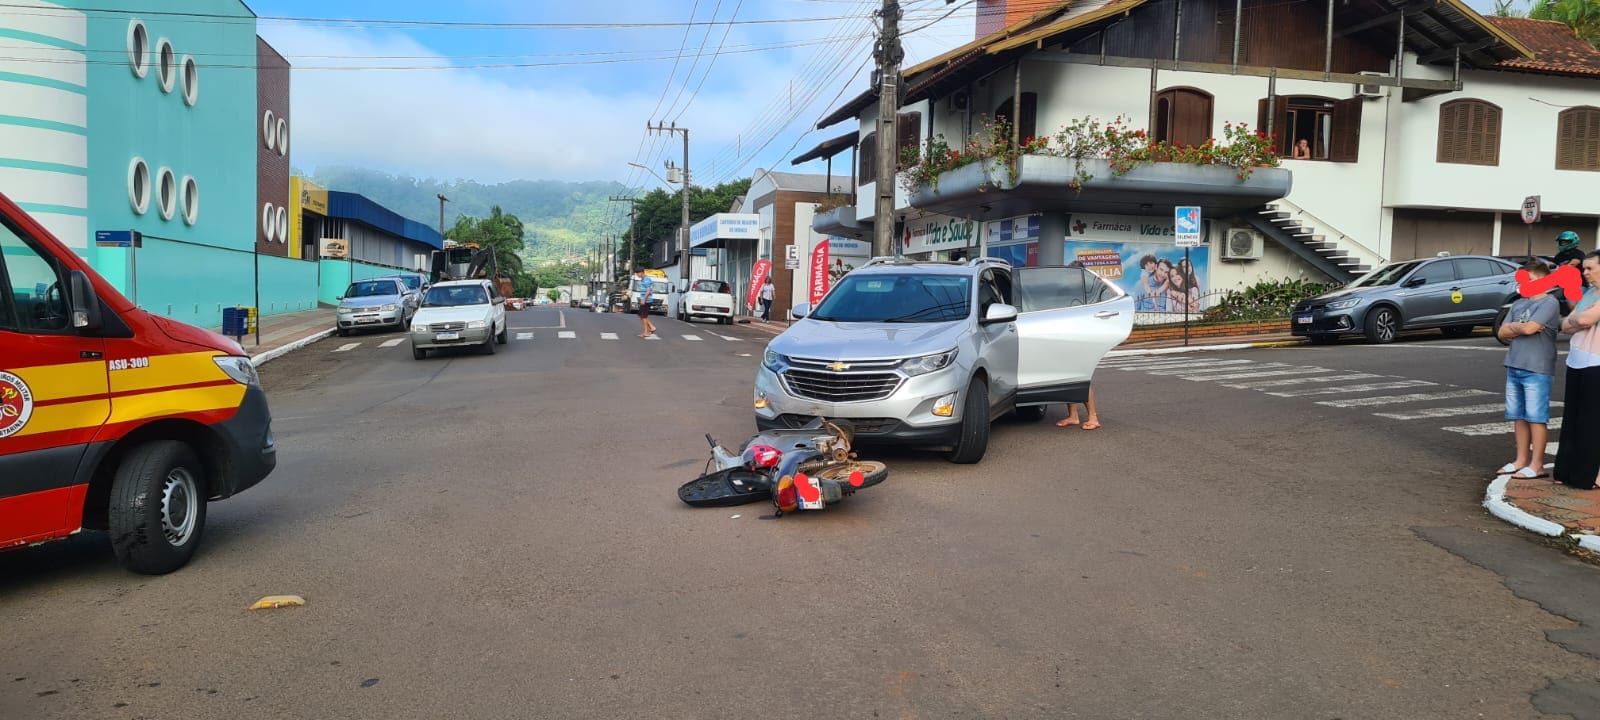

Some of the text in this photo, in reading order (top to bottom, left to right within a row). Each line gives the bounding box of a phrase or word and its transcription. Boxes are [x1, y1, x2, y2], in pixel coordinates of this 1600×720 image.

[1092, 221, 1132, 232] Farmácia
[1140, 223, 1161, 236] Vida
[789, 246, 797, 259] E
[814, 246, 825, 297] FARMÁCIA
[109, 357, 149, 370] ASU-300
